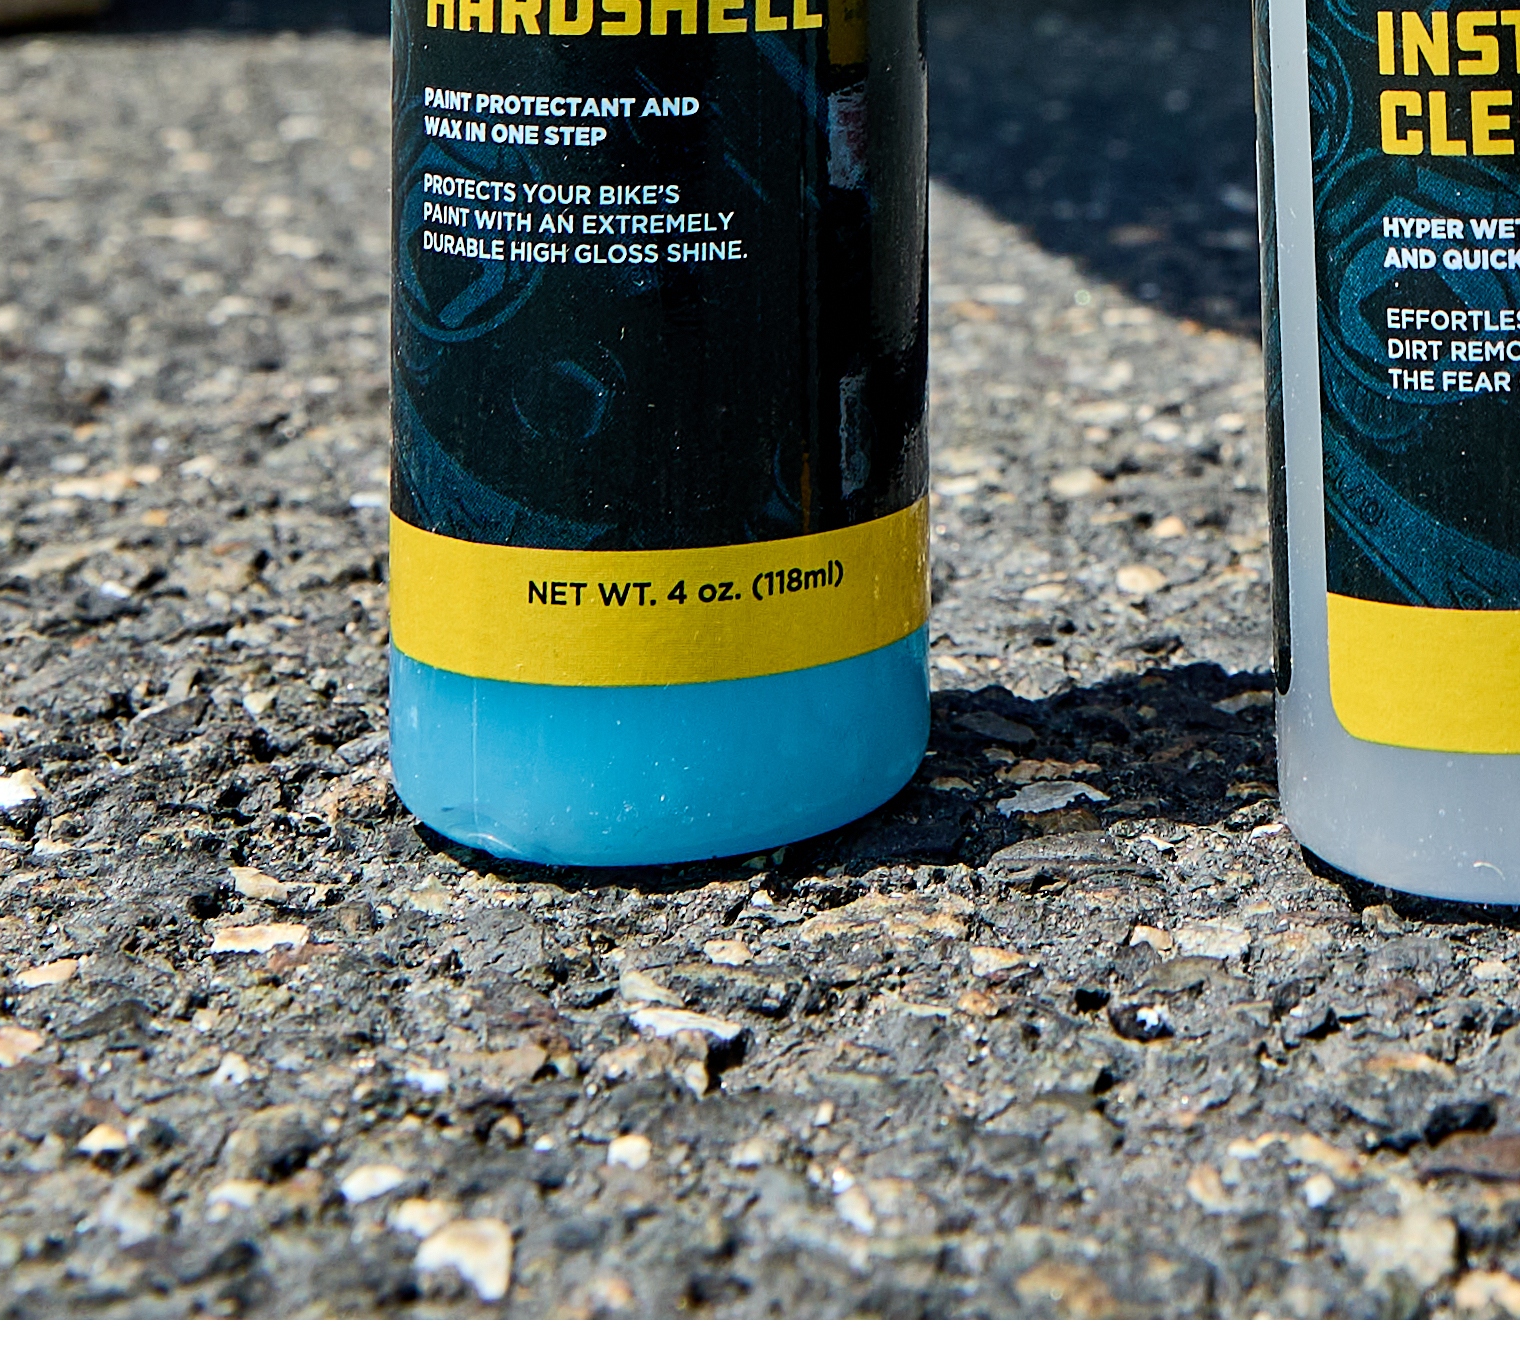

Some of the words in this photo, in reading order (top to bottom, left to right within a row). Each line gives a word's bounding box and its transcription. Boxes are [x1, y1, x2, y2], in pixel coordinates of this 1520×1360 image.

[424, 87, 469, 112] PAINT
[476, 93, 635, 117] PROTECTANT
[642, 96, 700, 117] AND
[425, 116, 463, 140] WAX
[465, 121, 486, 143] IN
[493, 124, 539, 145] ONE
[544, 126, 607, 146] STEP
[424, 173, 516, 202] PROTECTS
[523, 183, 590, 205] YOUR
[424, 202, 469, 227] PAINT
[474, 210, 531, 232] WITH
[539, 213, 574, 234] AN
[582, 211, 734, 234] EXTREMELY
[1383, 217, 1464, 240] HYPER
[424, 230, 504, 261] DURABLE
[510, 241, 567, 263] HIGH
[574, 243, 659, 264] GLOSS
[667, 240, 748, 263] SHINE.
[1384, 247, 1437, 270] AND
[1388, 338, 1442, 361] DIRT
[1388, 368, 1435, 391] THE
[1442, 370, 1511, 392] FEAR
[528, 581, 587, 606] NET
[598, 582, 657, 606] WT.
[667, 580, 687, 604] 4
[698, 583, 742, 603] oz.
[752, 560, 844, 601] (118ml)
